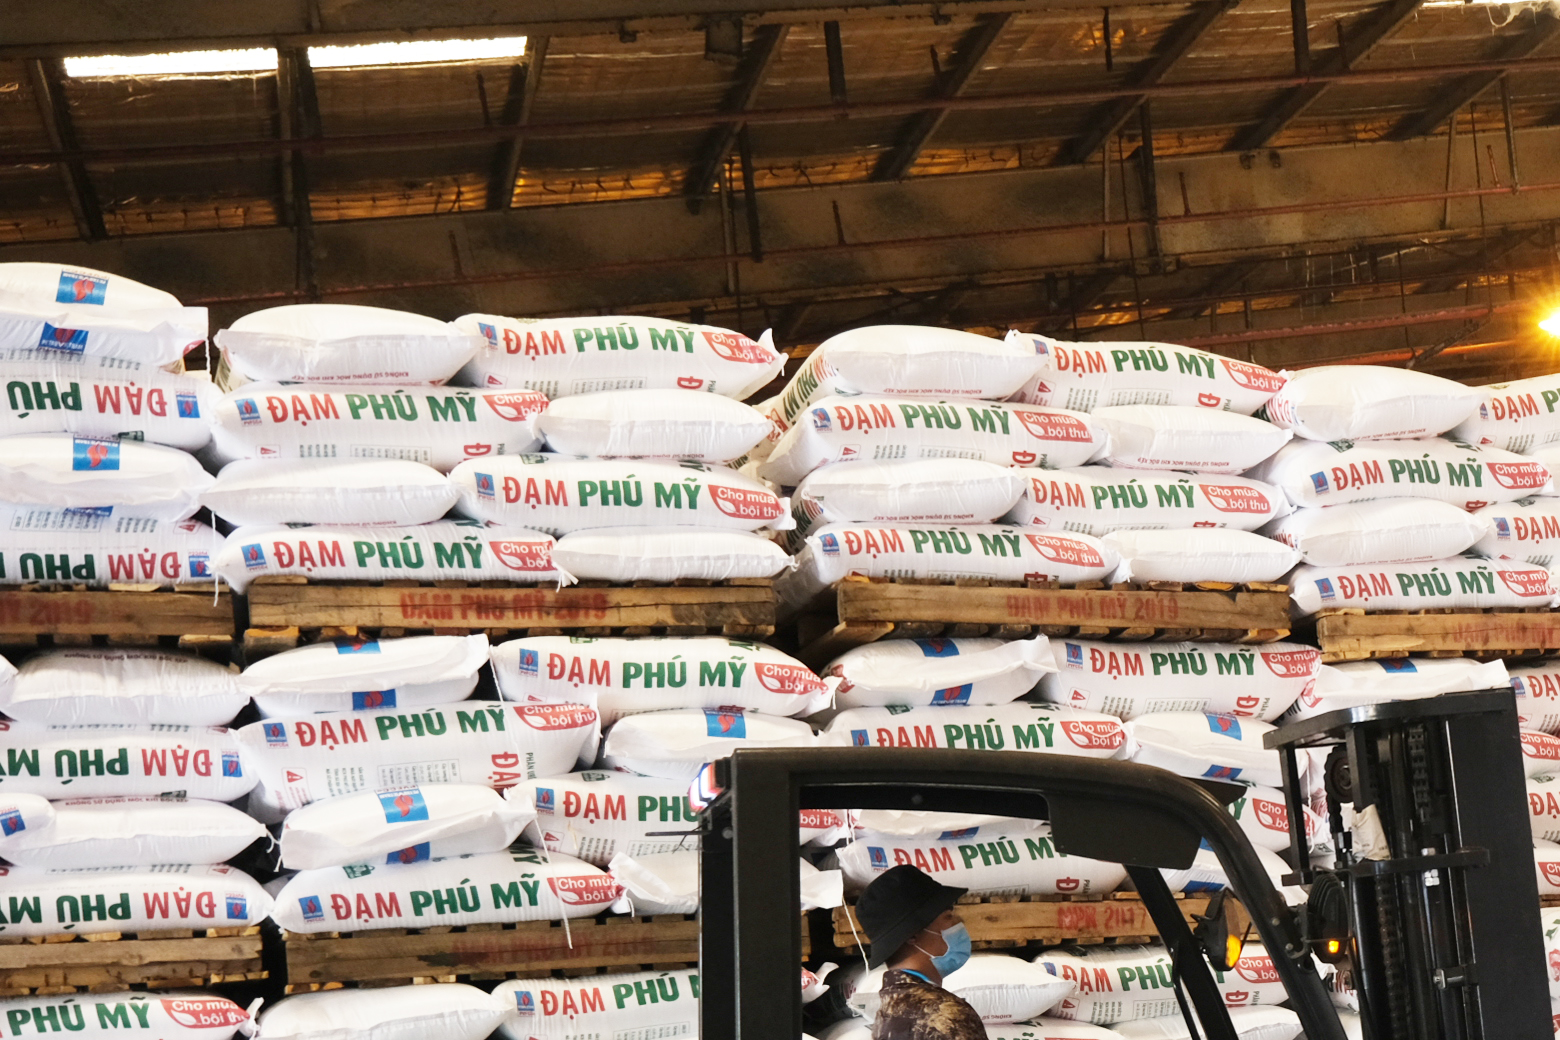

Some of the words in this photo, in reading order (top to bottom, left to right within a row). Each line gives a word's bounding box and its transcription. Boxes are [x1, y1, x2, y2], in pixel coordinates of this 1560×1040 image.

[502, 329, 566, 361] ĐẠM
[575, 327, 639, 352] PHÚ
[649, 328, 694, 353] MỸ
[266, 393, 340, 426] ĐẠM
[346, 388, 418, 421] PHÚ
[427, 391, 477, 422] MỸ
[835, 404, 896, 434] ĐẠM
[901, 398, 961, 429] PHÚ
[969, 403, 1010, 434] MỸ
[1024, 412, 1049, 424] Cho
[1069, 427, 1088, 439] thu
[502, 476, 568, 509] ĐẠM
[578, 475, 643, 507] PHÚ
[654, 478, 701, 509] MỸ
[718, 488, 744, 500] Cho
[1032, 478, 1086, 510] ĐẠM
[1092, 480, 1148, 509] PHÚ
[1156, 479, 1194, 508] MỸ
[1207, 486, 1230, 498] Cho
[1250, 500, 1268, 511] thu
[547, 653, 611, 688] ĐẠM
[623, 655, 687, 688] PHÚ
[700, 656, 747, 688] MỸ
[295, 719, 368, 750] ĐẠM
[376, 707, 447, 740] PHÚ
[457, 703, 505, 733] MỸ
[330, 892, 402, 923] ĐẠM
[411, 879, 481, 916] PHÚ
[491, 881, 540, 909] MỸ
